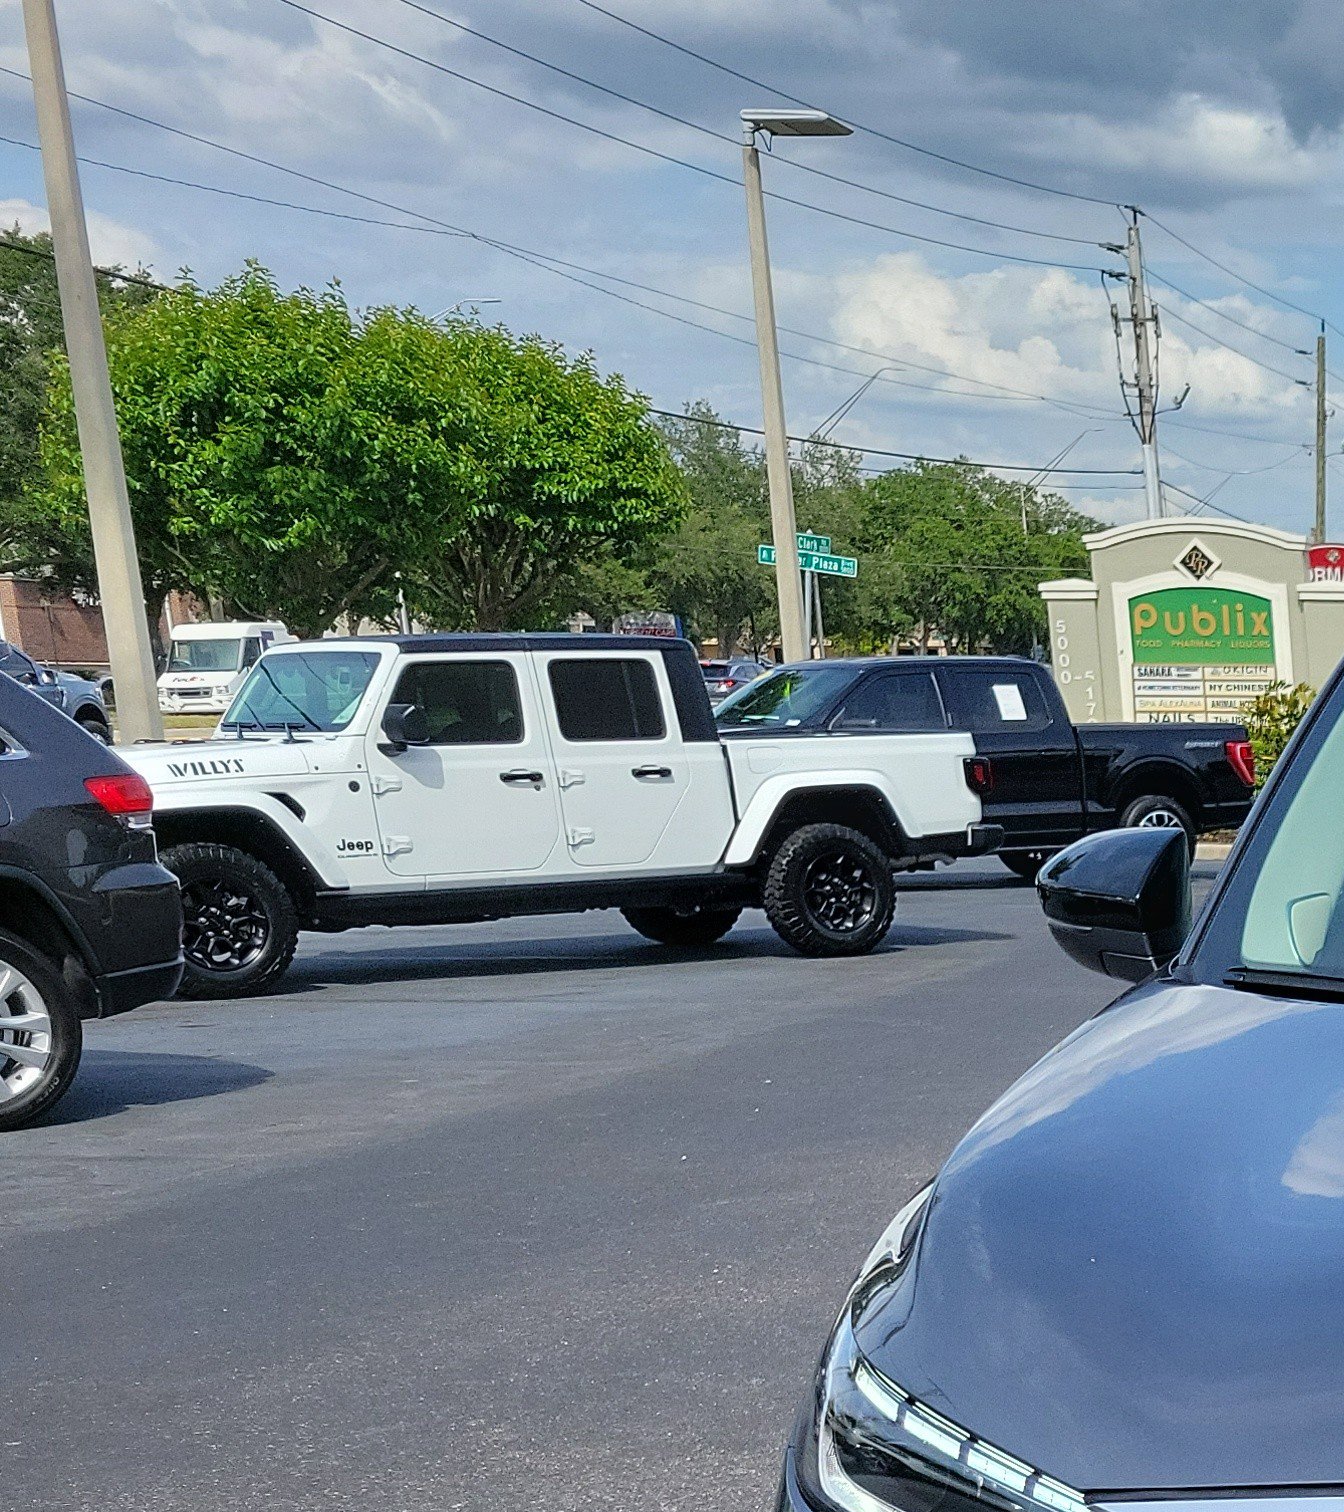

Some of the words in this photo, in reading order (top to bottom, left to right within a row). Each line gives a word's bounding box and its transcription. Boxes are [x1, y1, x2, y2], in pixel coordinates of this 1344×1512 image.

[798, 536, 818, 552] Clark
[811, 556, 839, 571] Plaza
[1133, 602, 1270, 637] Publix
[1136, 639, 1163, 648] FOOD
[1171, 639, 1222, 649] PHARMACY
[1230, 640, 1271, 649] LIQUORS
[1137, 666, 1173, 677] SAHARA
[1209, 684, 1223, 692] NY
[166, 758, 245, 778] WILLYS
[336, 838, 374, 853] Jeep
